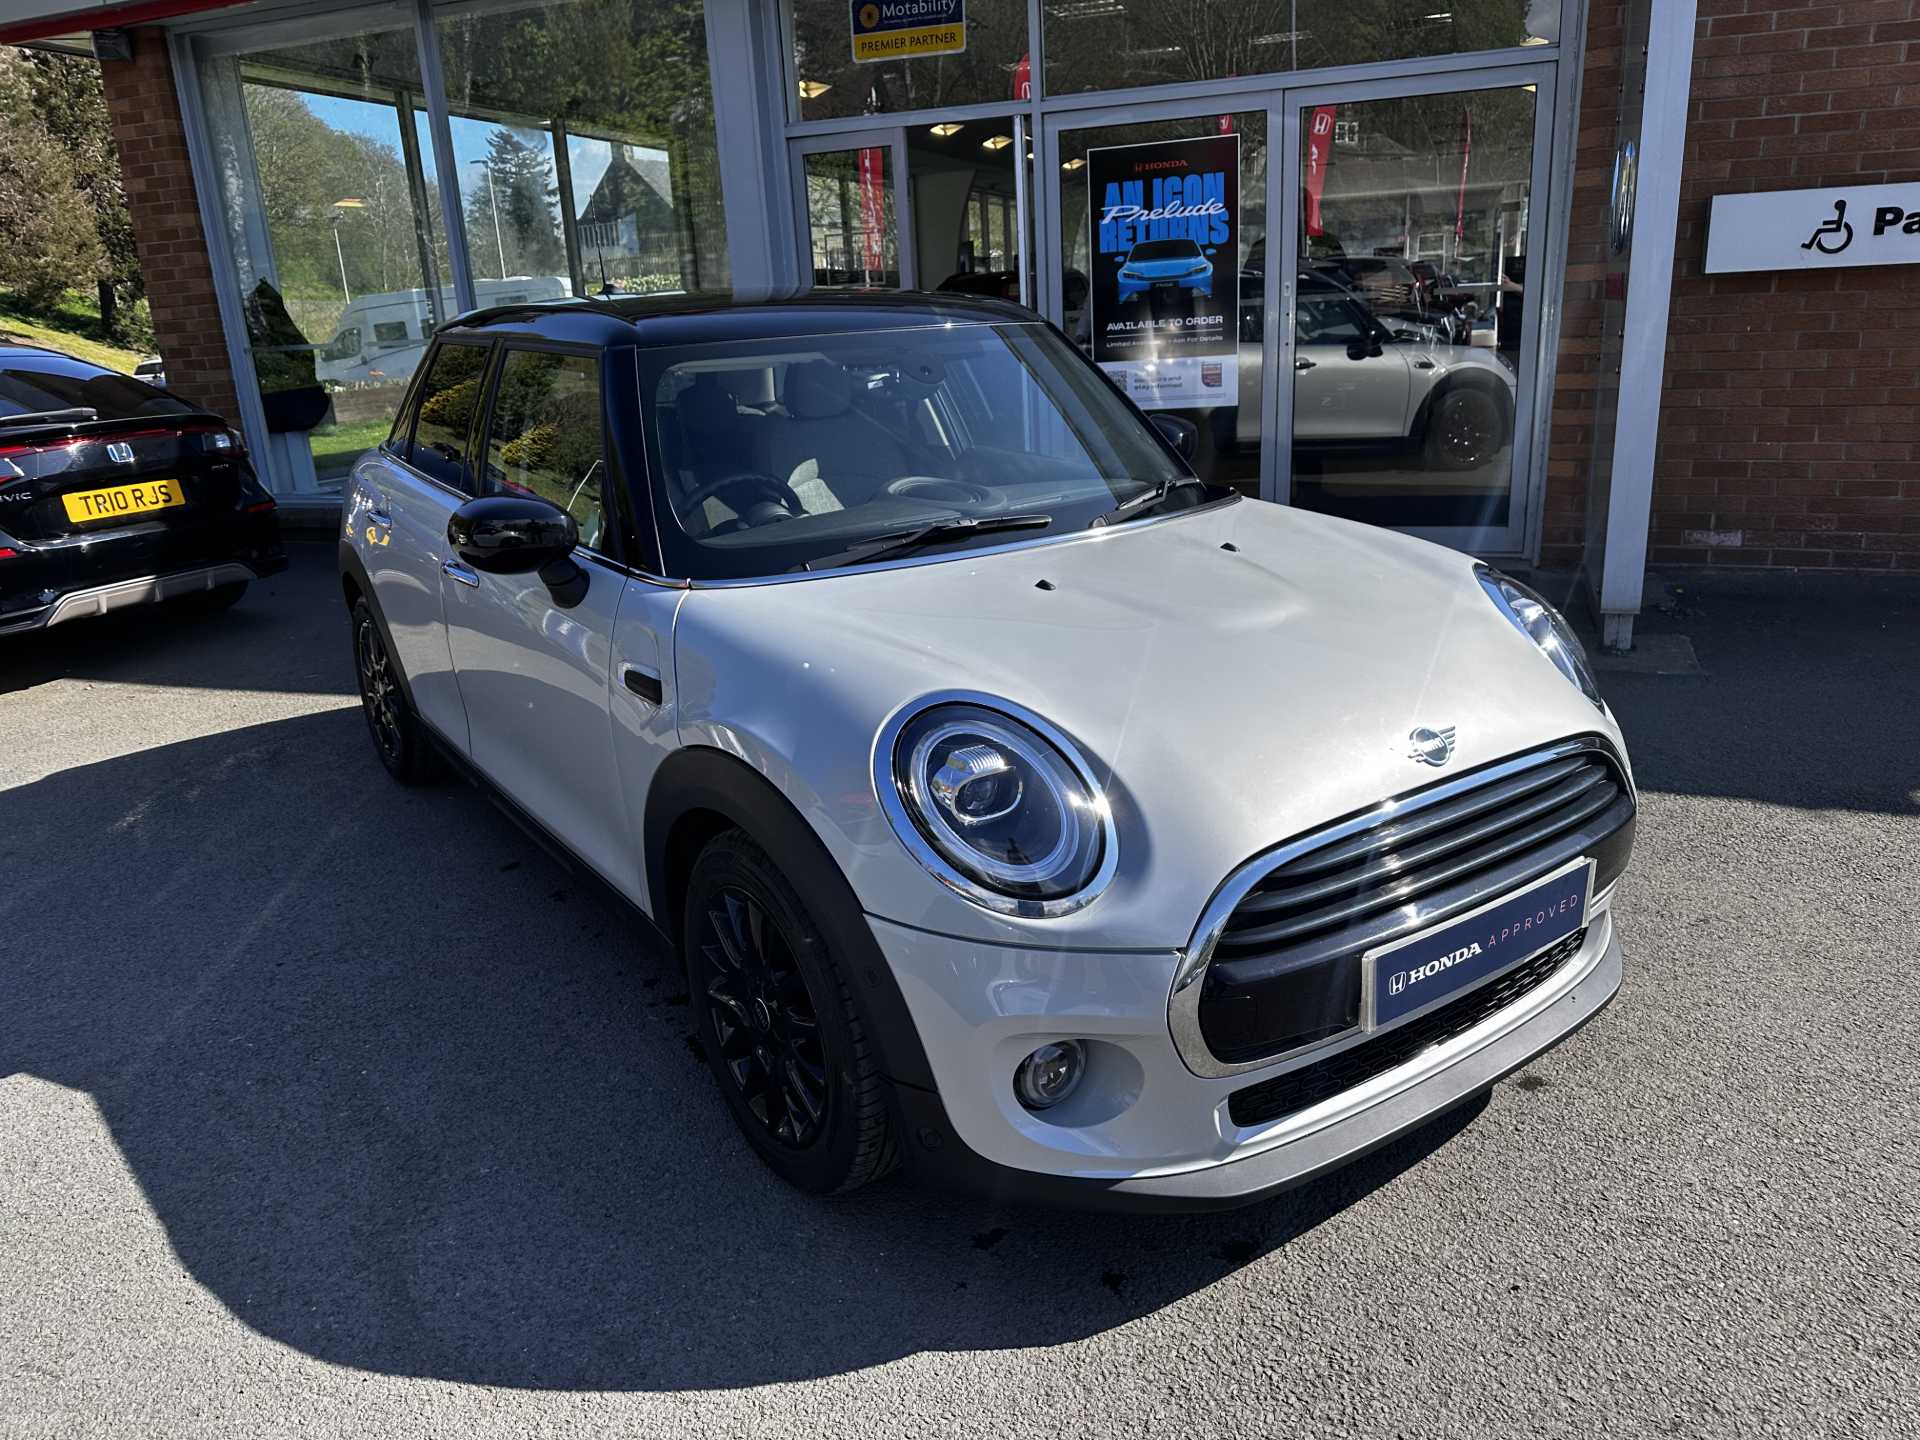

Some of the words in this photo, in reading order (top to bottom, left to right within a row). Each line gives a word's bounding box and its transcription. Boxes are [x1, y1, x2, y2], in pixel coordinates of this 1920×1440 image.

[882, 0, 956, 17] Motability
[861, 38, 906, 52] PREMIER
[910, 31, 956, 46] PARTNER
[1145, 160, 1188, 170] HONDA
[1104, 180, 1144, 218] AN
[1152, 171, 1225, 214] ICON
[1101, 197, 1226, 225] Prelude
[1099, 209, 1230, 253] RETURNS
[1106, 319, 1166, 332] AVAILABLE
[1168, 318, 1183, 327] TO
[1186, 315, 1223, 326] ORDER
[131, 484, 172, 508] RJS
[1408, 942, 1483, 986] HONDA
[1488, 894, 1578, 949] APPROVED
